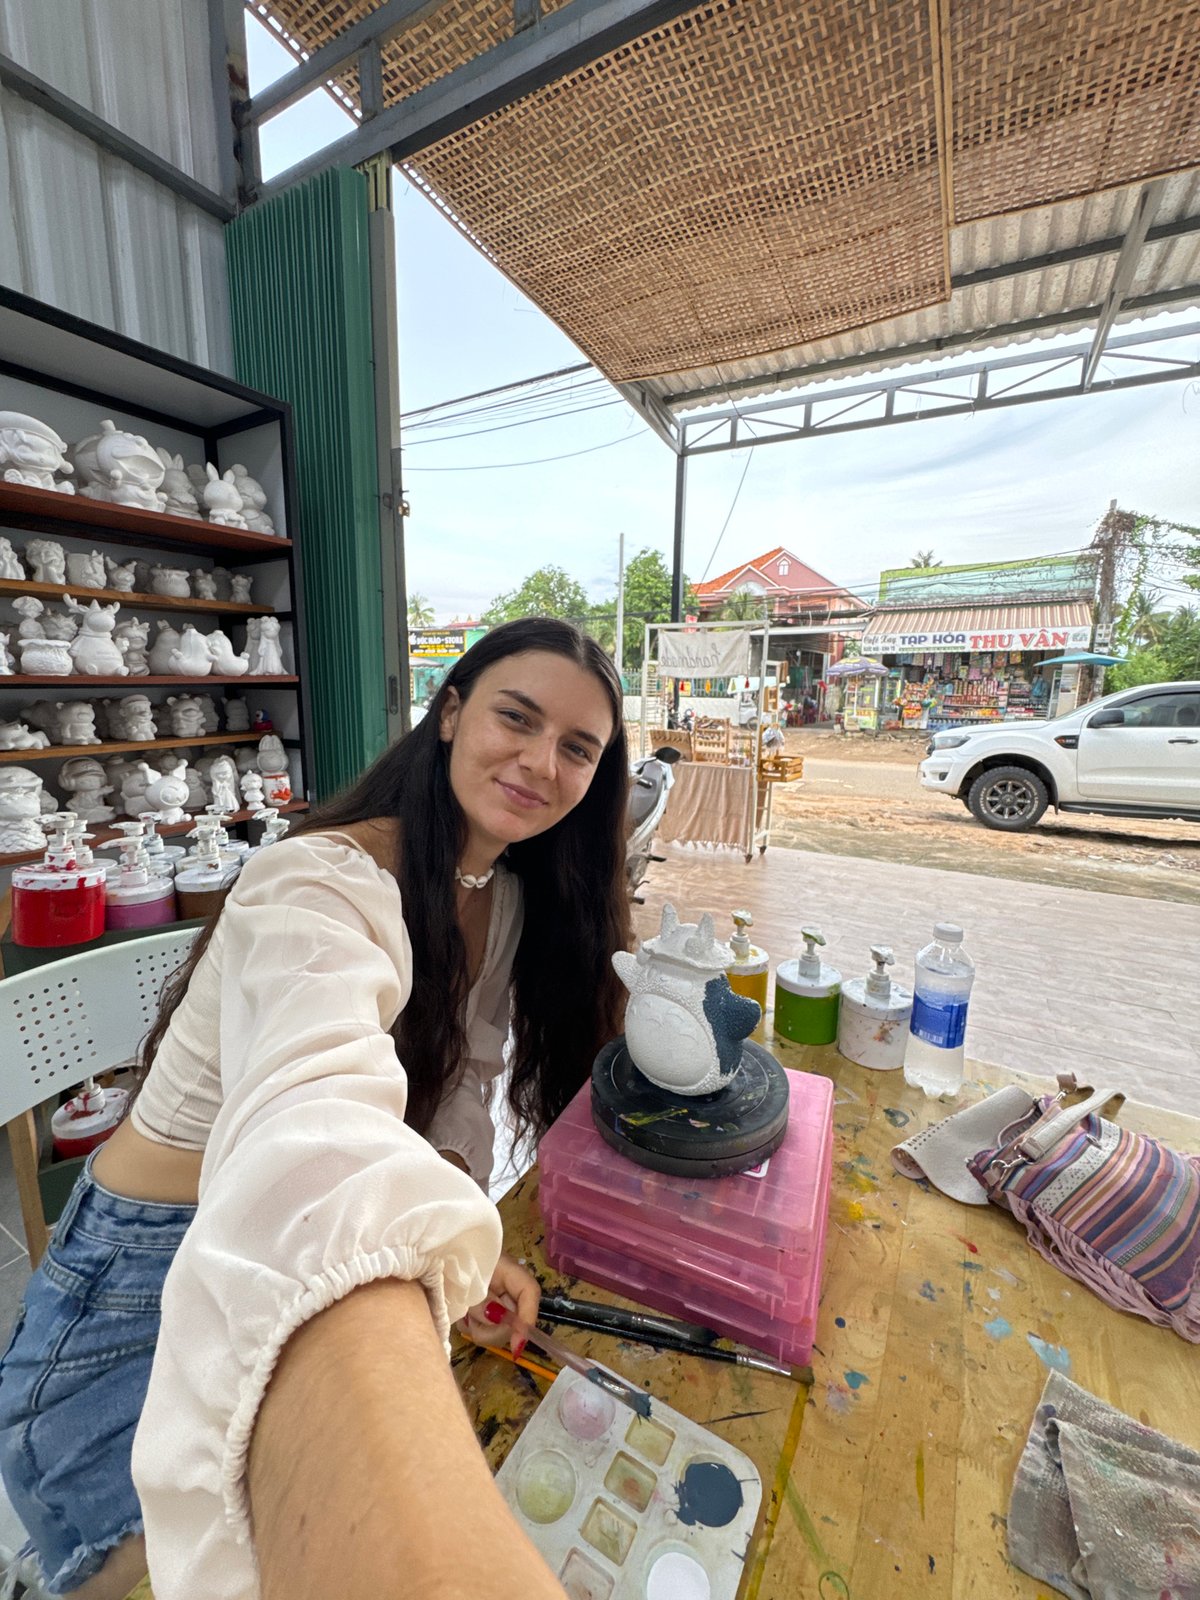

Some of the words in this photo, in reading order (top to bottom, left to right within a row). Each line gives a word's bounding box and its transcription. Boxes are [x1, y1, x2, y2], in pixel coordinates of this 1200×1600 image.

[900, 636, 928, 647] TẠP
[932, 632, 966, 644] HÓA
[969, 634, 1014, 649] THU
[1019, 629, 1069, 648] VÂN
